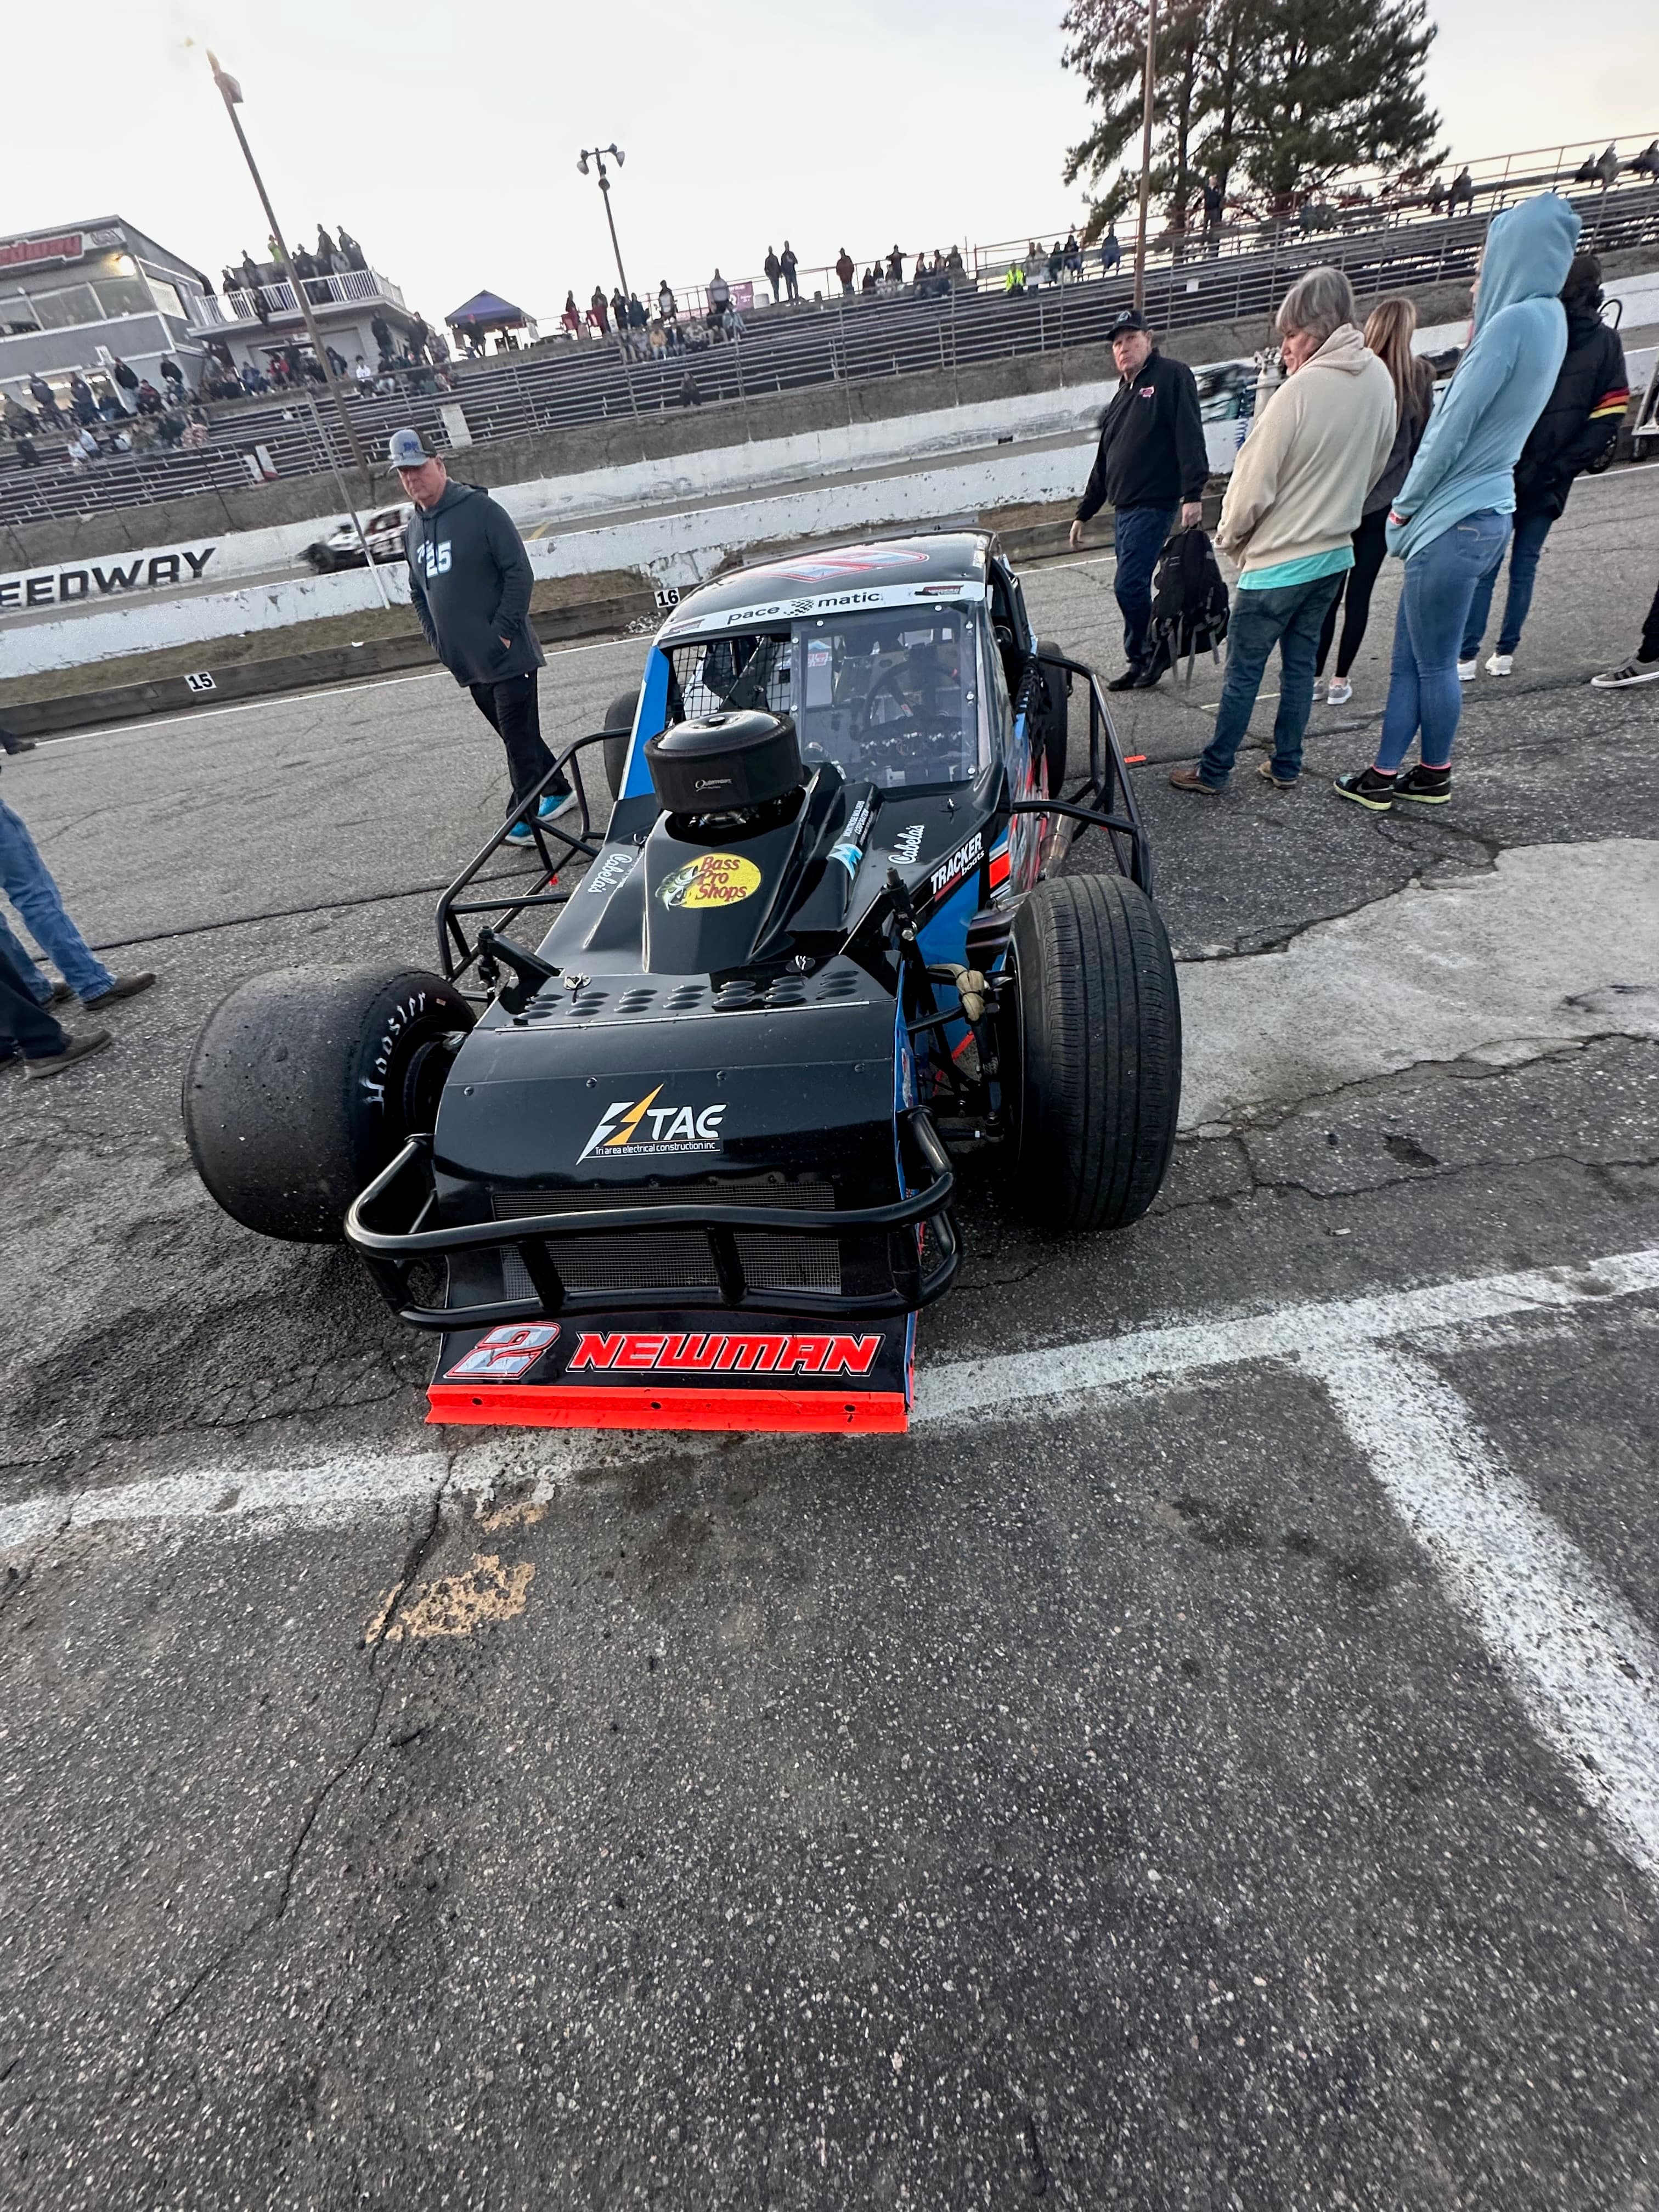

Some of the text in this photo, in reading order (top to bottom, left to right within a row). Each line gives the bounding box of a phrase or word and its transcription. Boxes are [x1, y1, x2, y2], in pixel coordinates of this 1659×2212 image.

[657, 590, 679, 606] 16
[727, 592, 880, 625] pace matic
[188, 674, 213, 690] 15
[888, 823, 925, 865] Cabela's
[588, 853, 633, 893] Cabela's
[699, 856, 741, 872] Bass
[931, 832, 983, 895] TRACKER
[962, 850, 984, 877] boats
[698, 870, 729, 885] Pro
[695, 883, 748, 902] Shops
[595, 1141, 715, 1155] Tri area electrical construction inc
[442, 1322, 885, 1379] 2 NEWMAN
